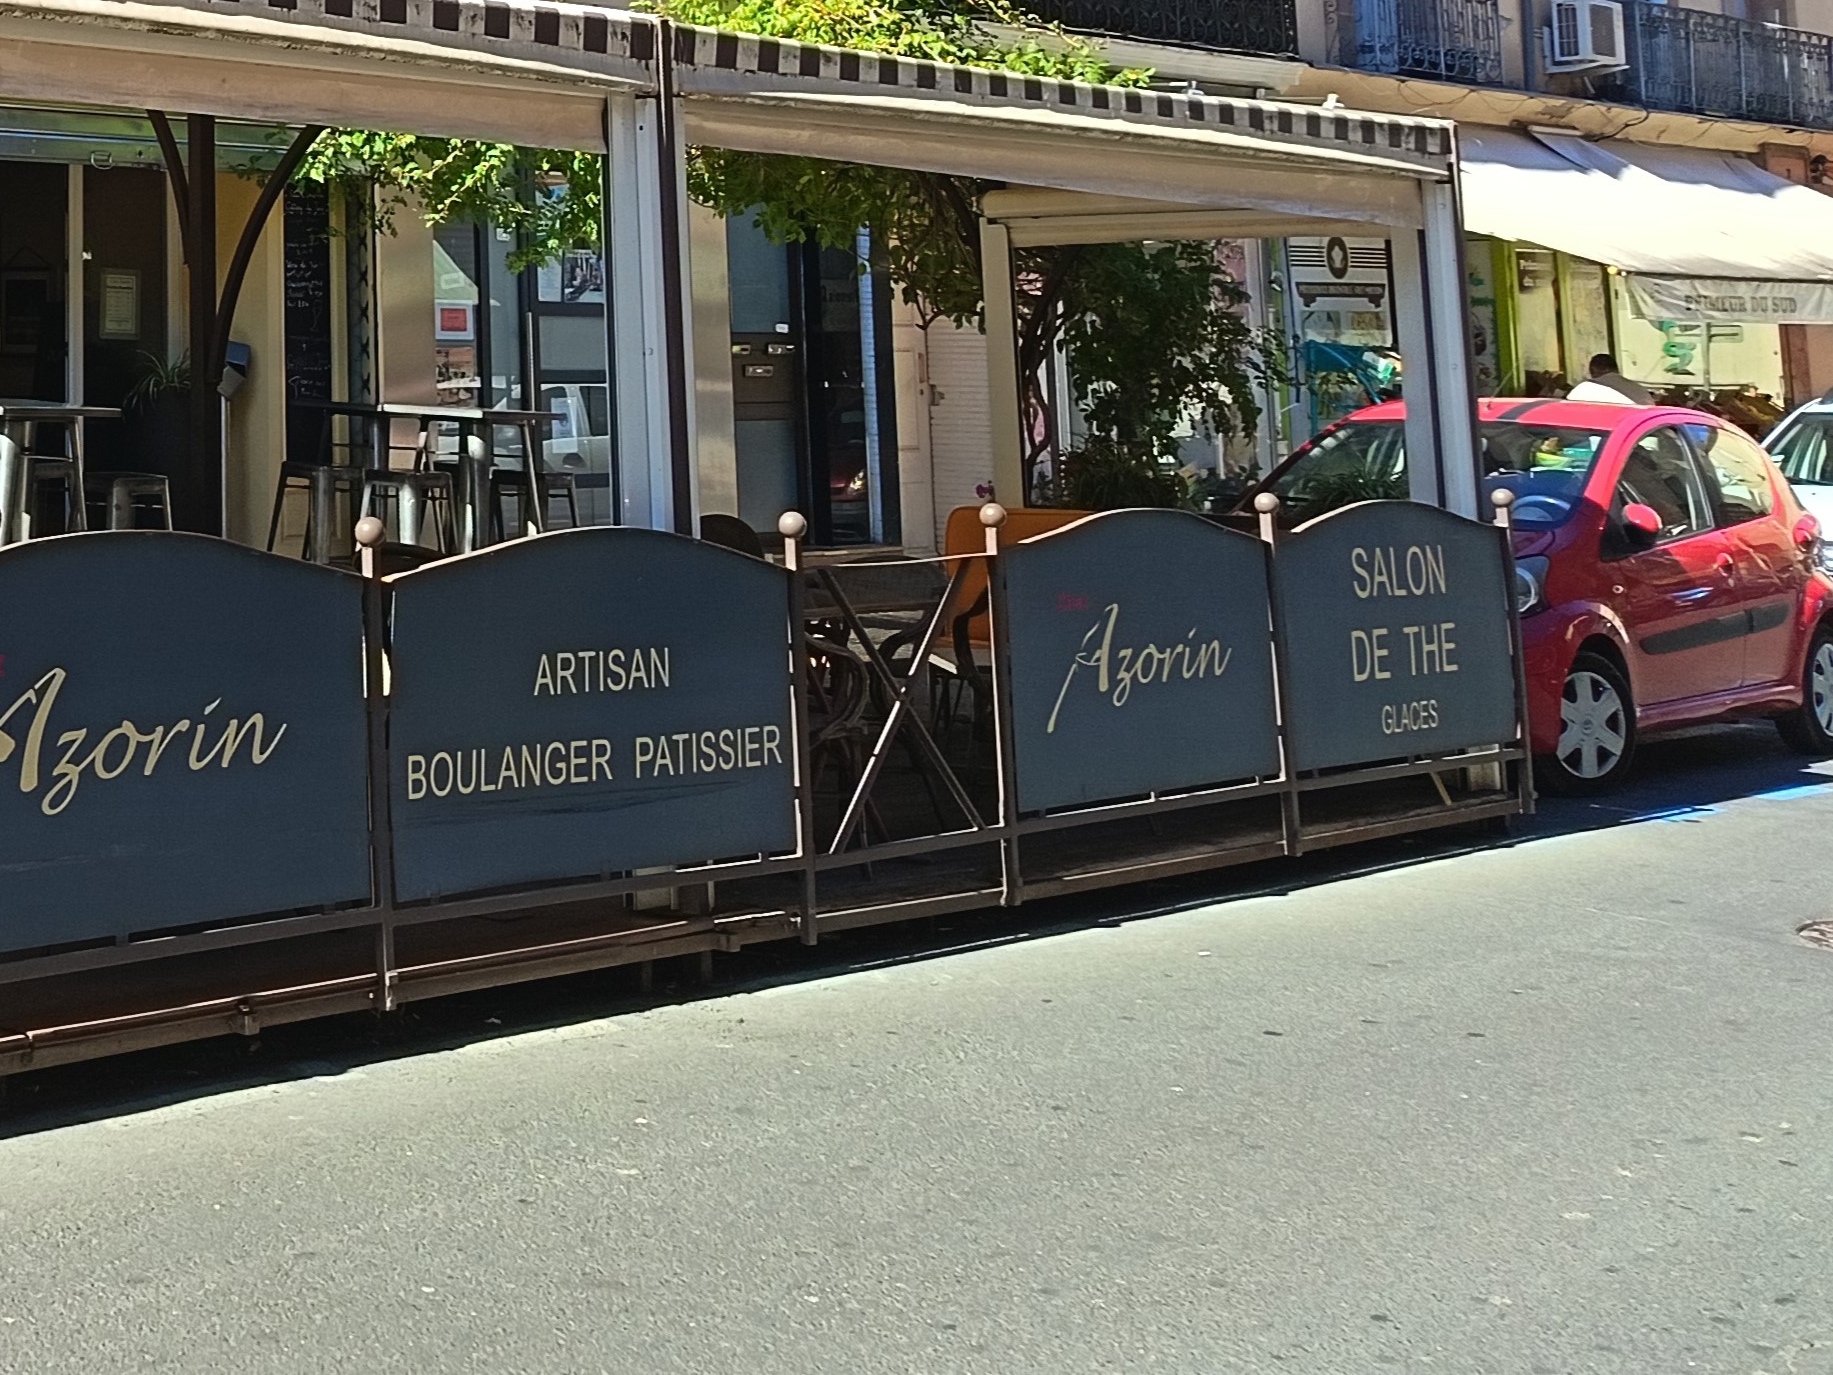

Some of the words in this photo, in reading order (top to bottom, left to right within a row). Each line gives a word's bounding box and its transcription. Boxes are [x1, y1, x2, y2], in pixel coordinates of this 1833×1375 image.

[1771, 296, 1798, 314] SUD
[1351, 545, 1447, 599] SALON
[533, 647, 670, 696] ARTISAN
[1046, 603, 1232, 733] Azorin
[1351, 627, 1392, 682] DE
[1403, 622, 1458, 676] THE
[1381, 699, 1439, 734] GLACES
[407, 738, 613, 800] BOULANGER
[635, 724, 783, 779] PATISSIER
